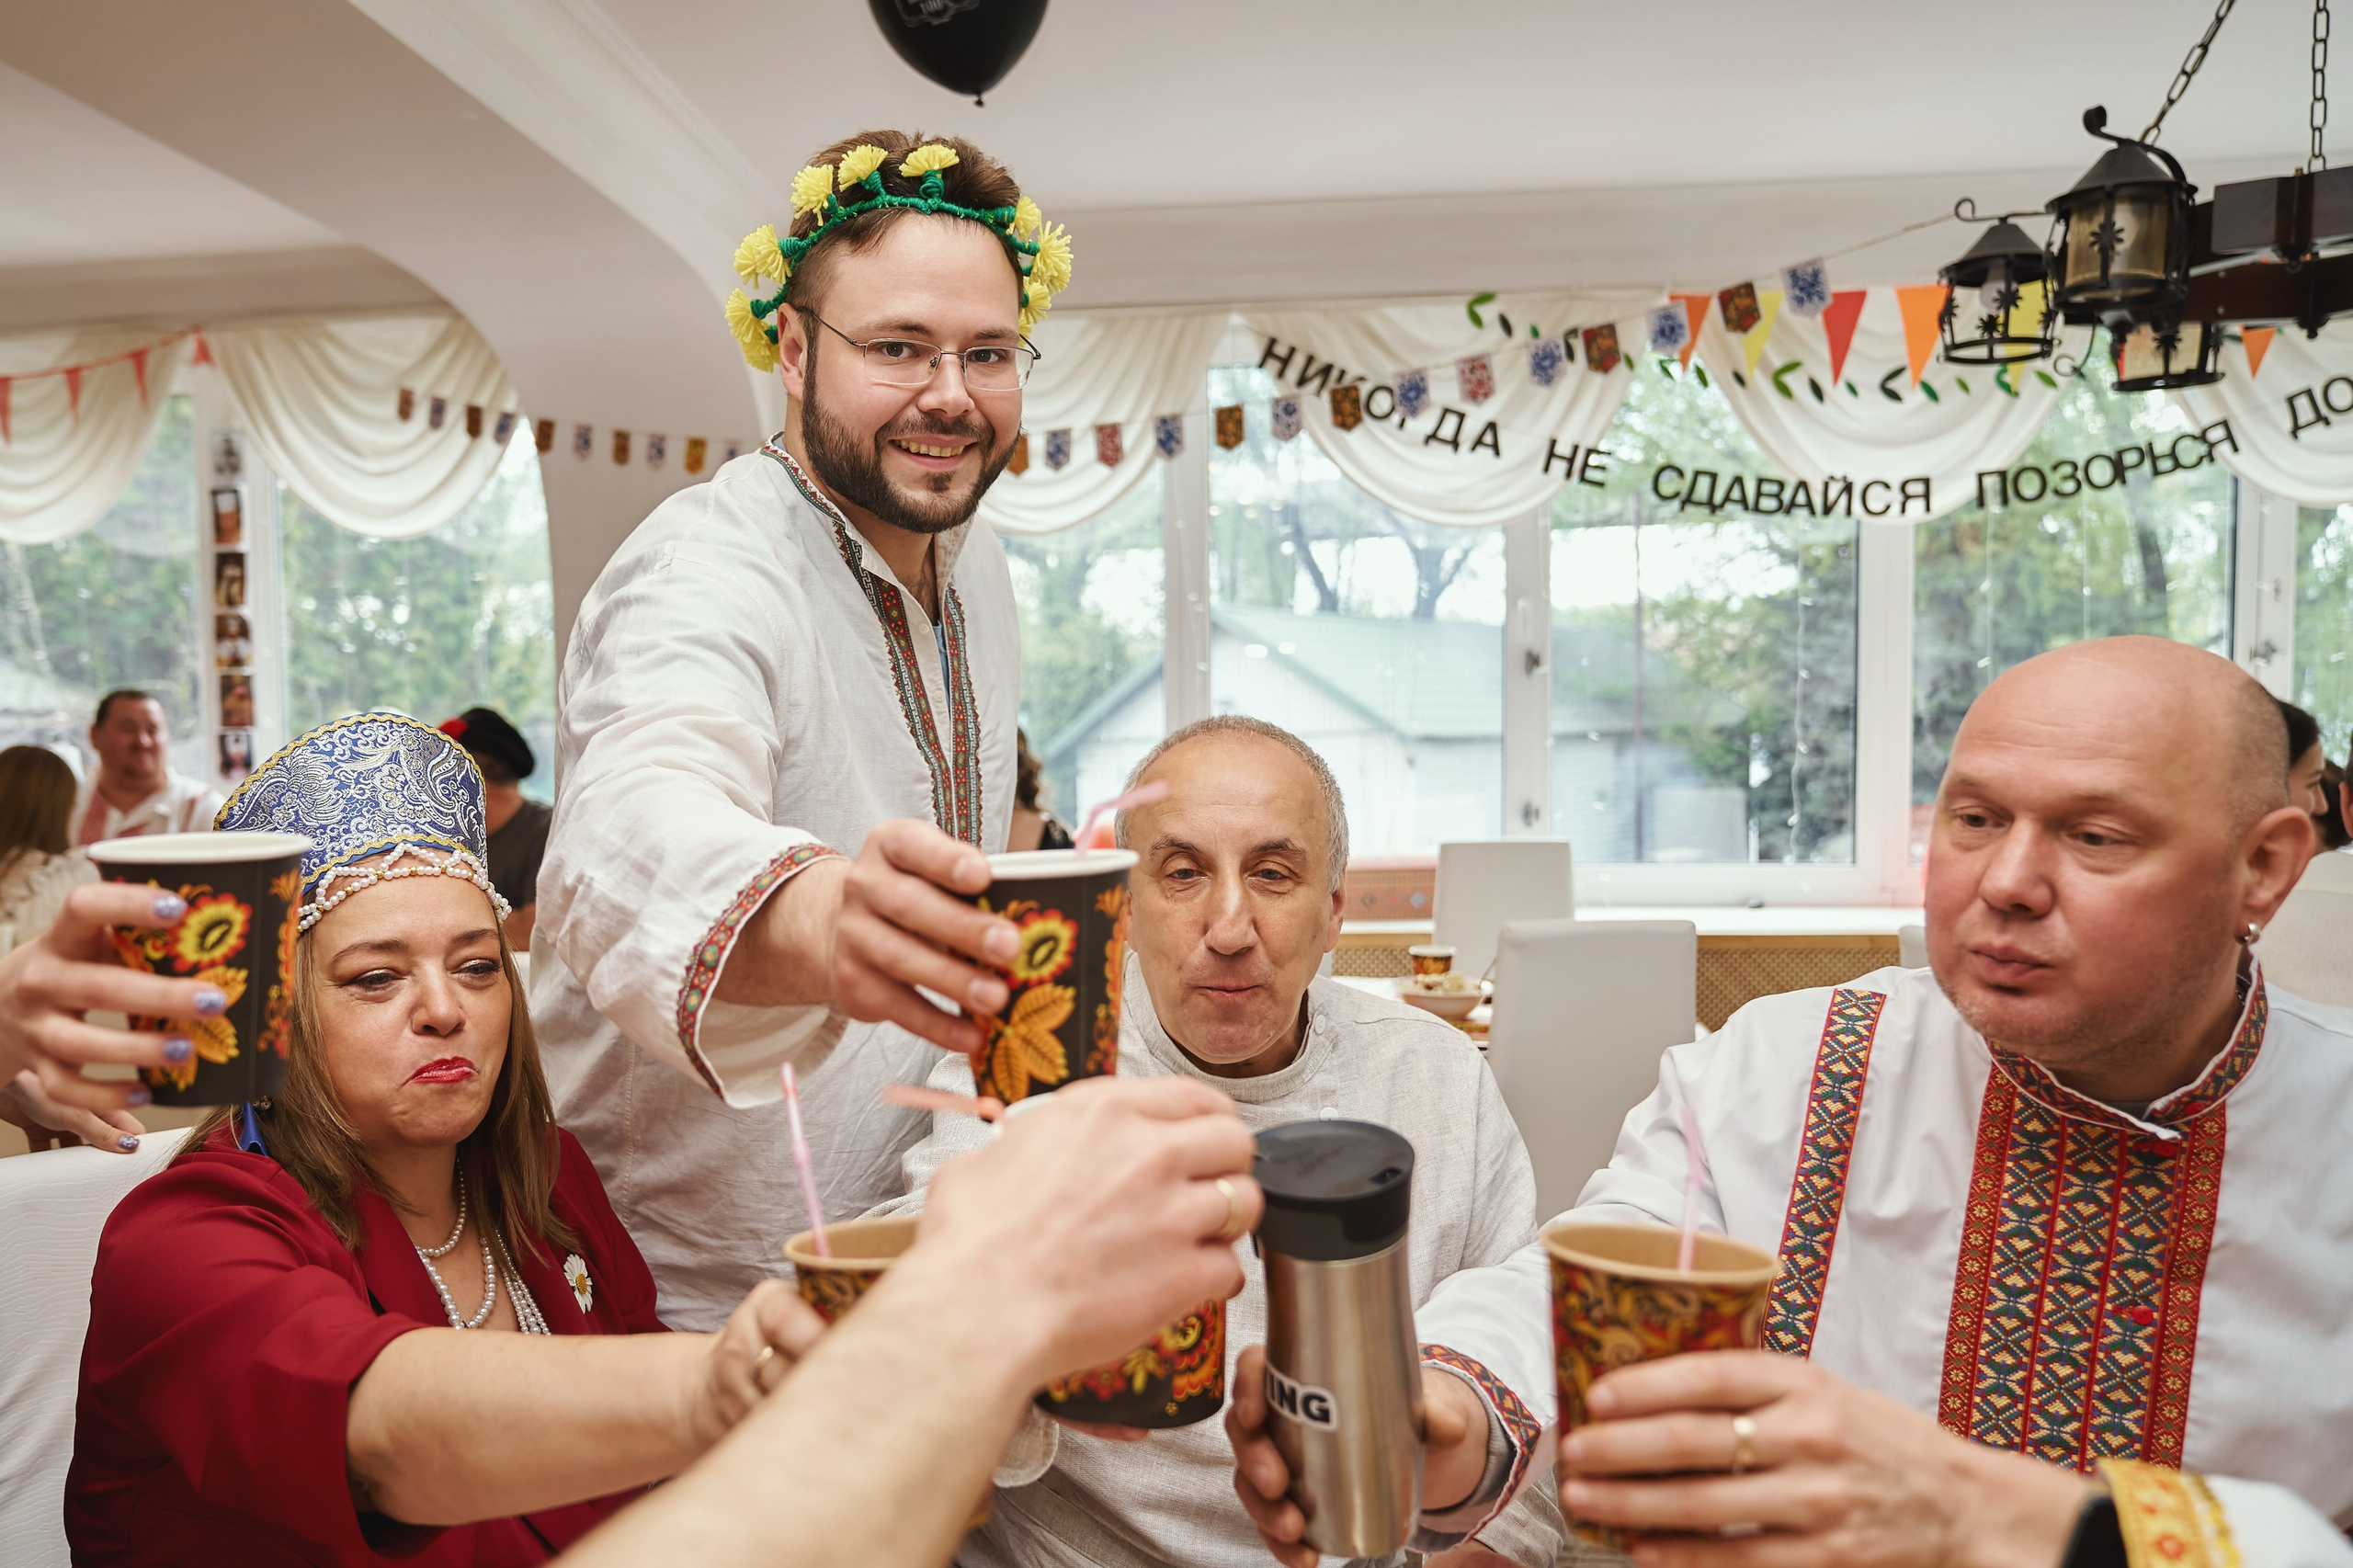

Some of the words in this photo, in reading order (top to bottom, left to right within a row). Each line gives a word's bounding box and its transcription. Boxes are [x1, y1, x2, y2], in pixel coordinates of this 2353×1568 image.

[1257, 336, 1500, 457] НИОДА
[1541, 438, 1613, 488] НЕ
[1653, 464, 1931, 518] СДАВАЙСЯ
[1976, 418, 2240, 509] ПОЗОРЬСЯ
[1267, 1369, 1330, 1424] ING
